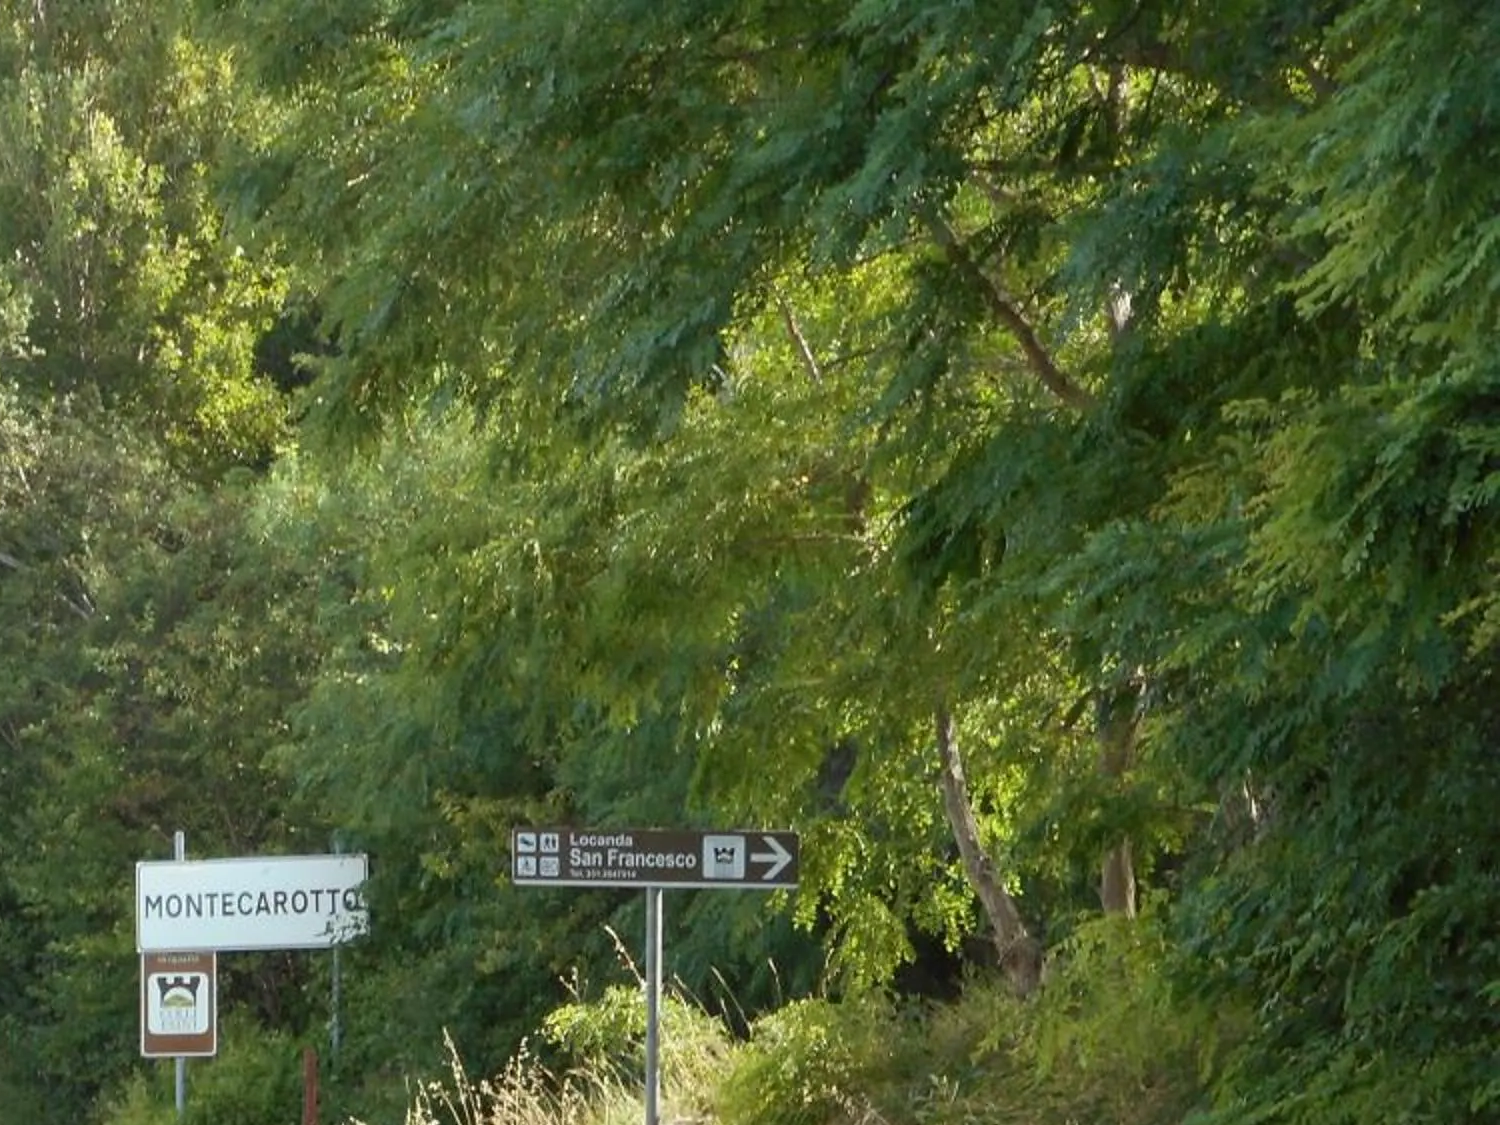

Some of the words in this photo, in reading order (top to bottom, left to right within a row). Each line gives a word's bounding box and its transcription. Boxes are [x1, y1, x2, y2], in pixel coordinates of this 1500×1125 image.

[569, 832, 633, 847] Locanda
[570, 848, 603, 867] San
[607, 848, 697, 868] Francesco
[144, 888, 360, 919] MONTECAROTTO
